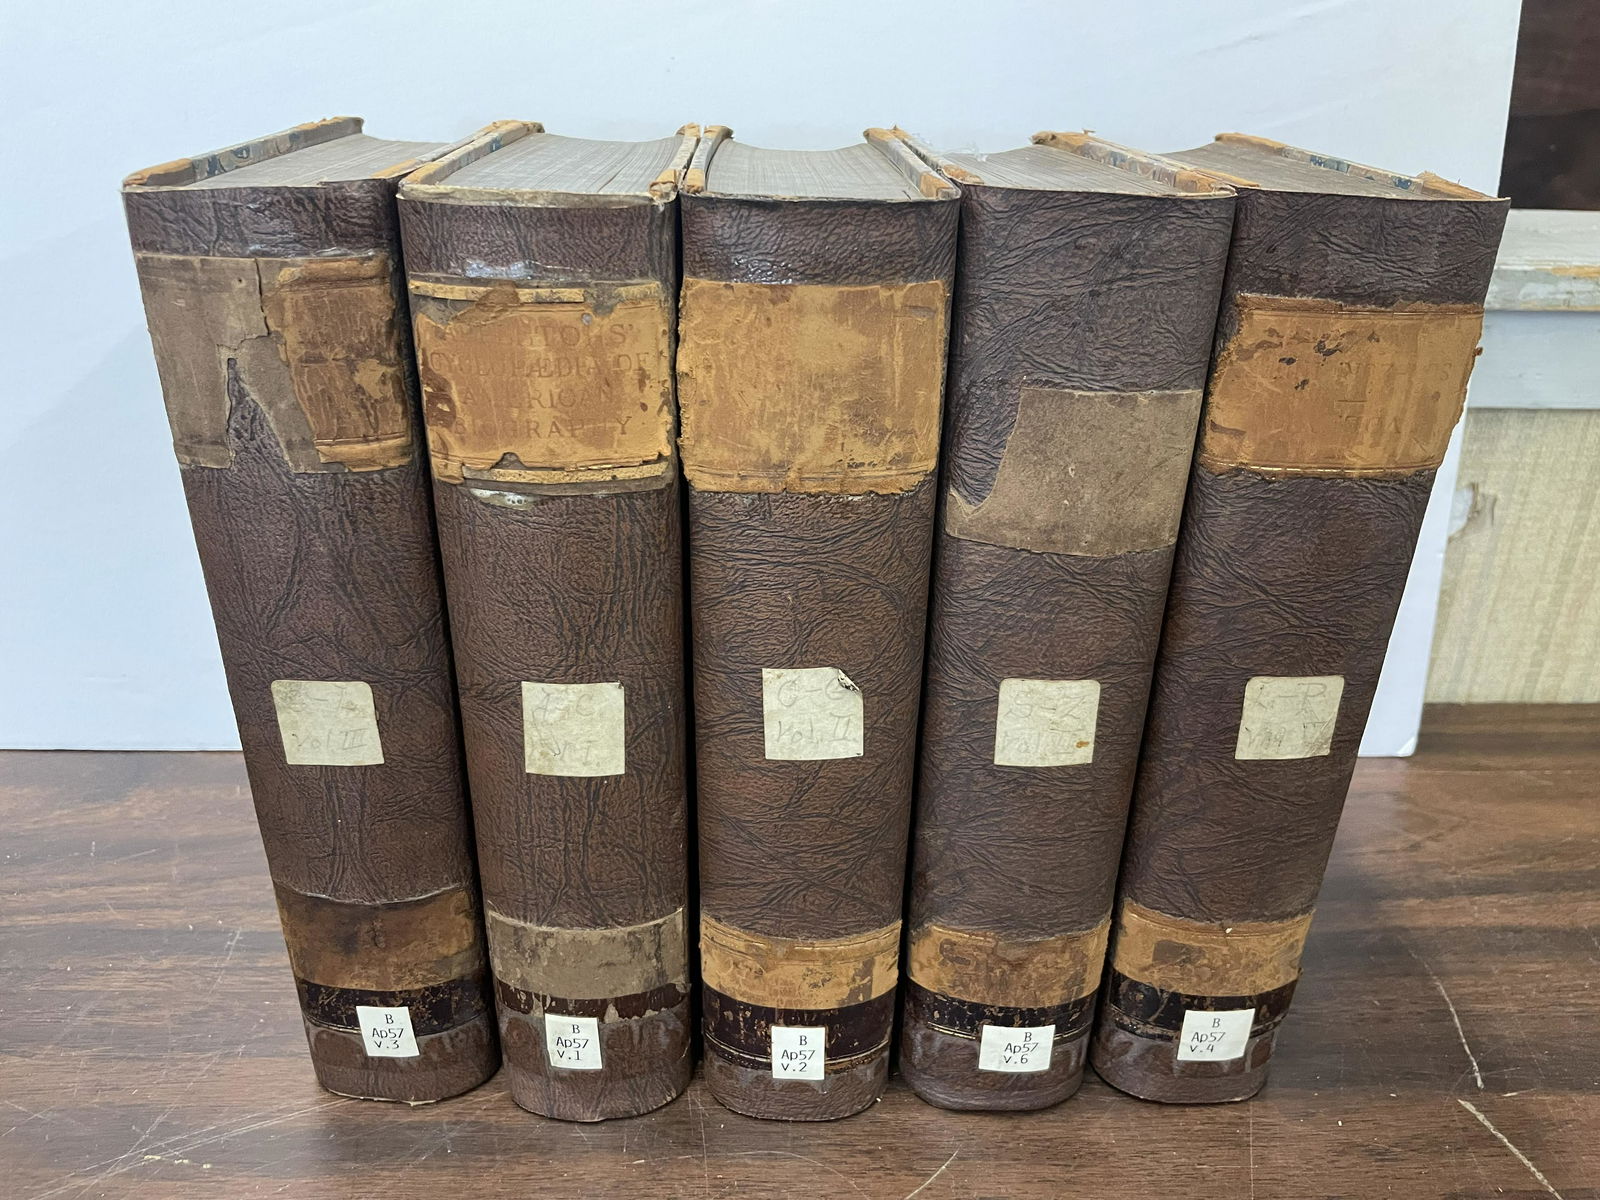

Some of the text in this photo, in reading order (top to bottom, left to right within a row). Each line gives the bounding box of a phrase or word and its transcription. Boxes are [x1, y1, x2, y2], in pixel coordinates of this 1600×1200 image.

[384, 1013, 395, 1025] B
[1210, 1018, 1221, 1029] B
[371, 1027, 405, 1039] Ap57
[571, 1023, 581, 1034] B
[556, 1036, 590, 1049] Ap57
[798, 1034, 808, 1046] B
[1023, 1031, 1033, 1043] B
[1190, 1031, 1227, 1044] Ap57
[1003, 1042, 1040, 1055] Ap57
[780, 1049, 816, 1061] Ap57
